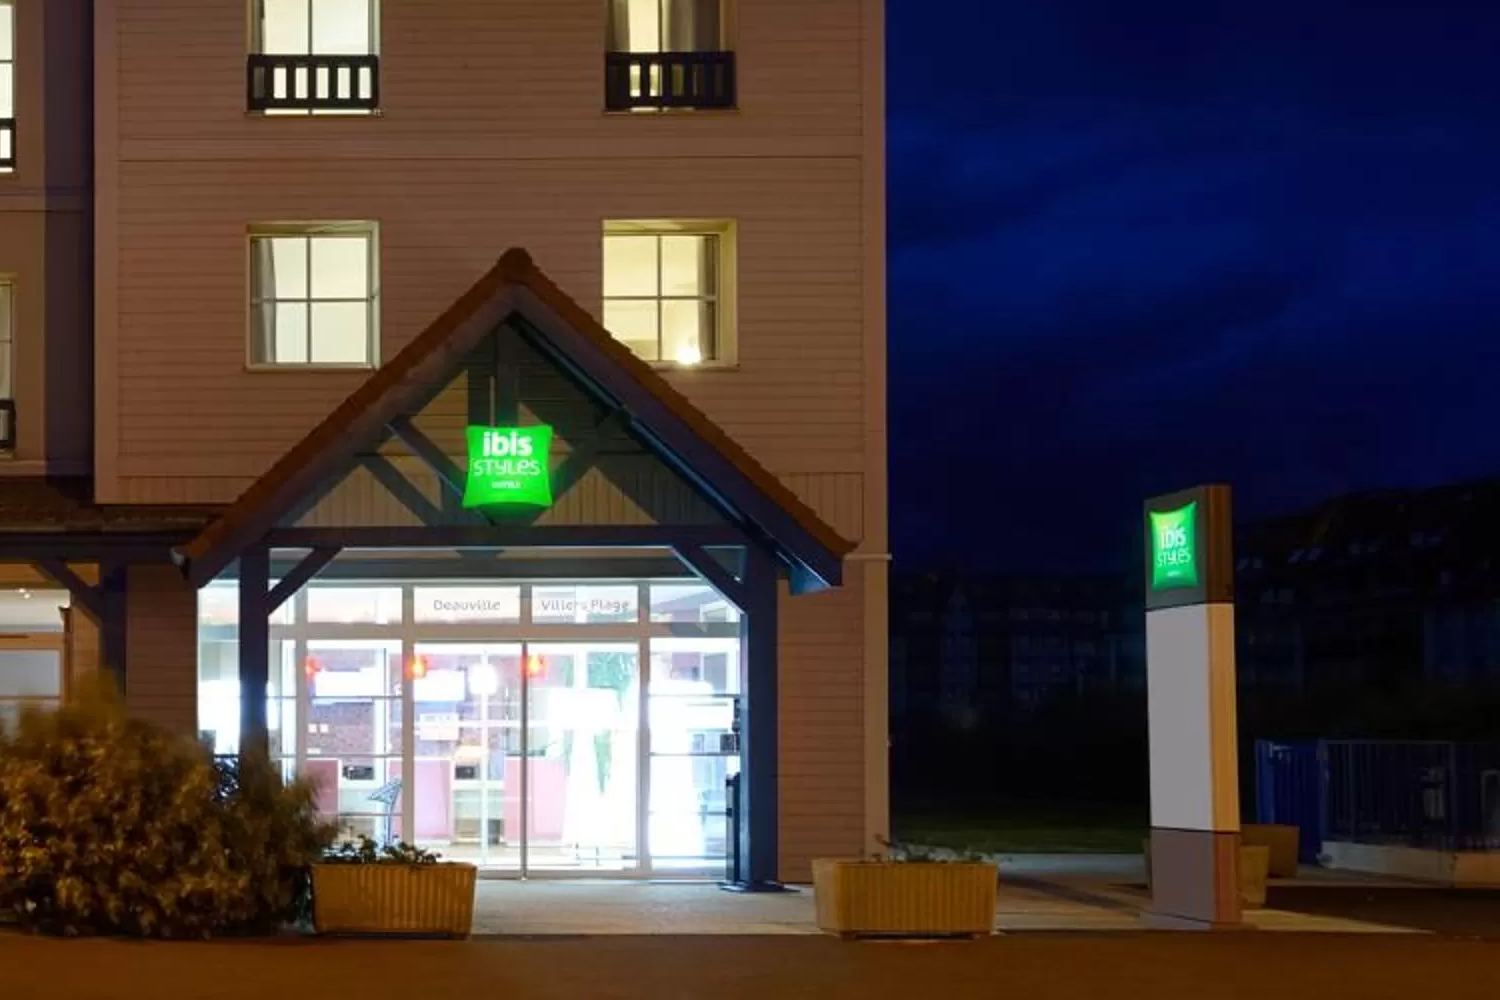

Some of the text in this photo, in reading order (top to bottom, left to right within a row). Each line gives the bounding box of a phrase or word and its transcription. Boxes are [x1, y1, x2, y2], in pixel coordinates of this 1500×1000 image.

[483, 431, 533, 457] ibis
[1160, 523, 1187, 549] ibis
[433, 599, 501, 611] Deauville
[591, 599, 629, 613] Plage
